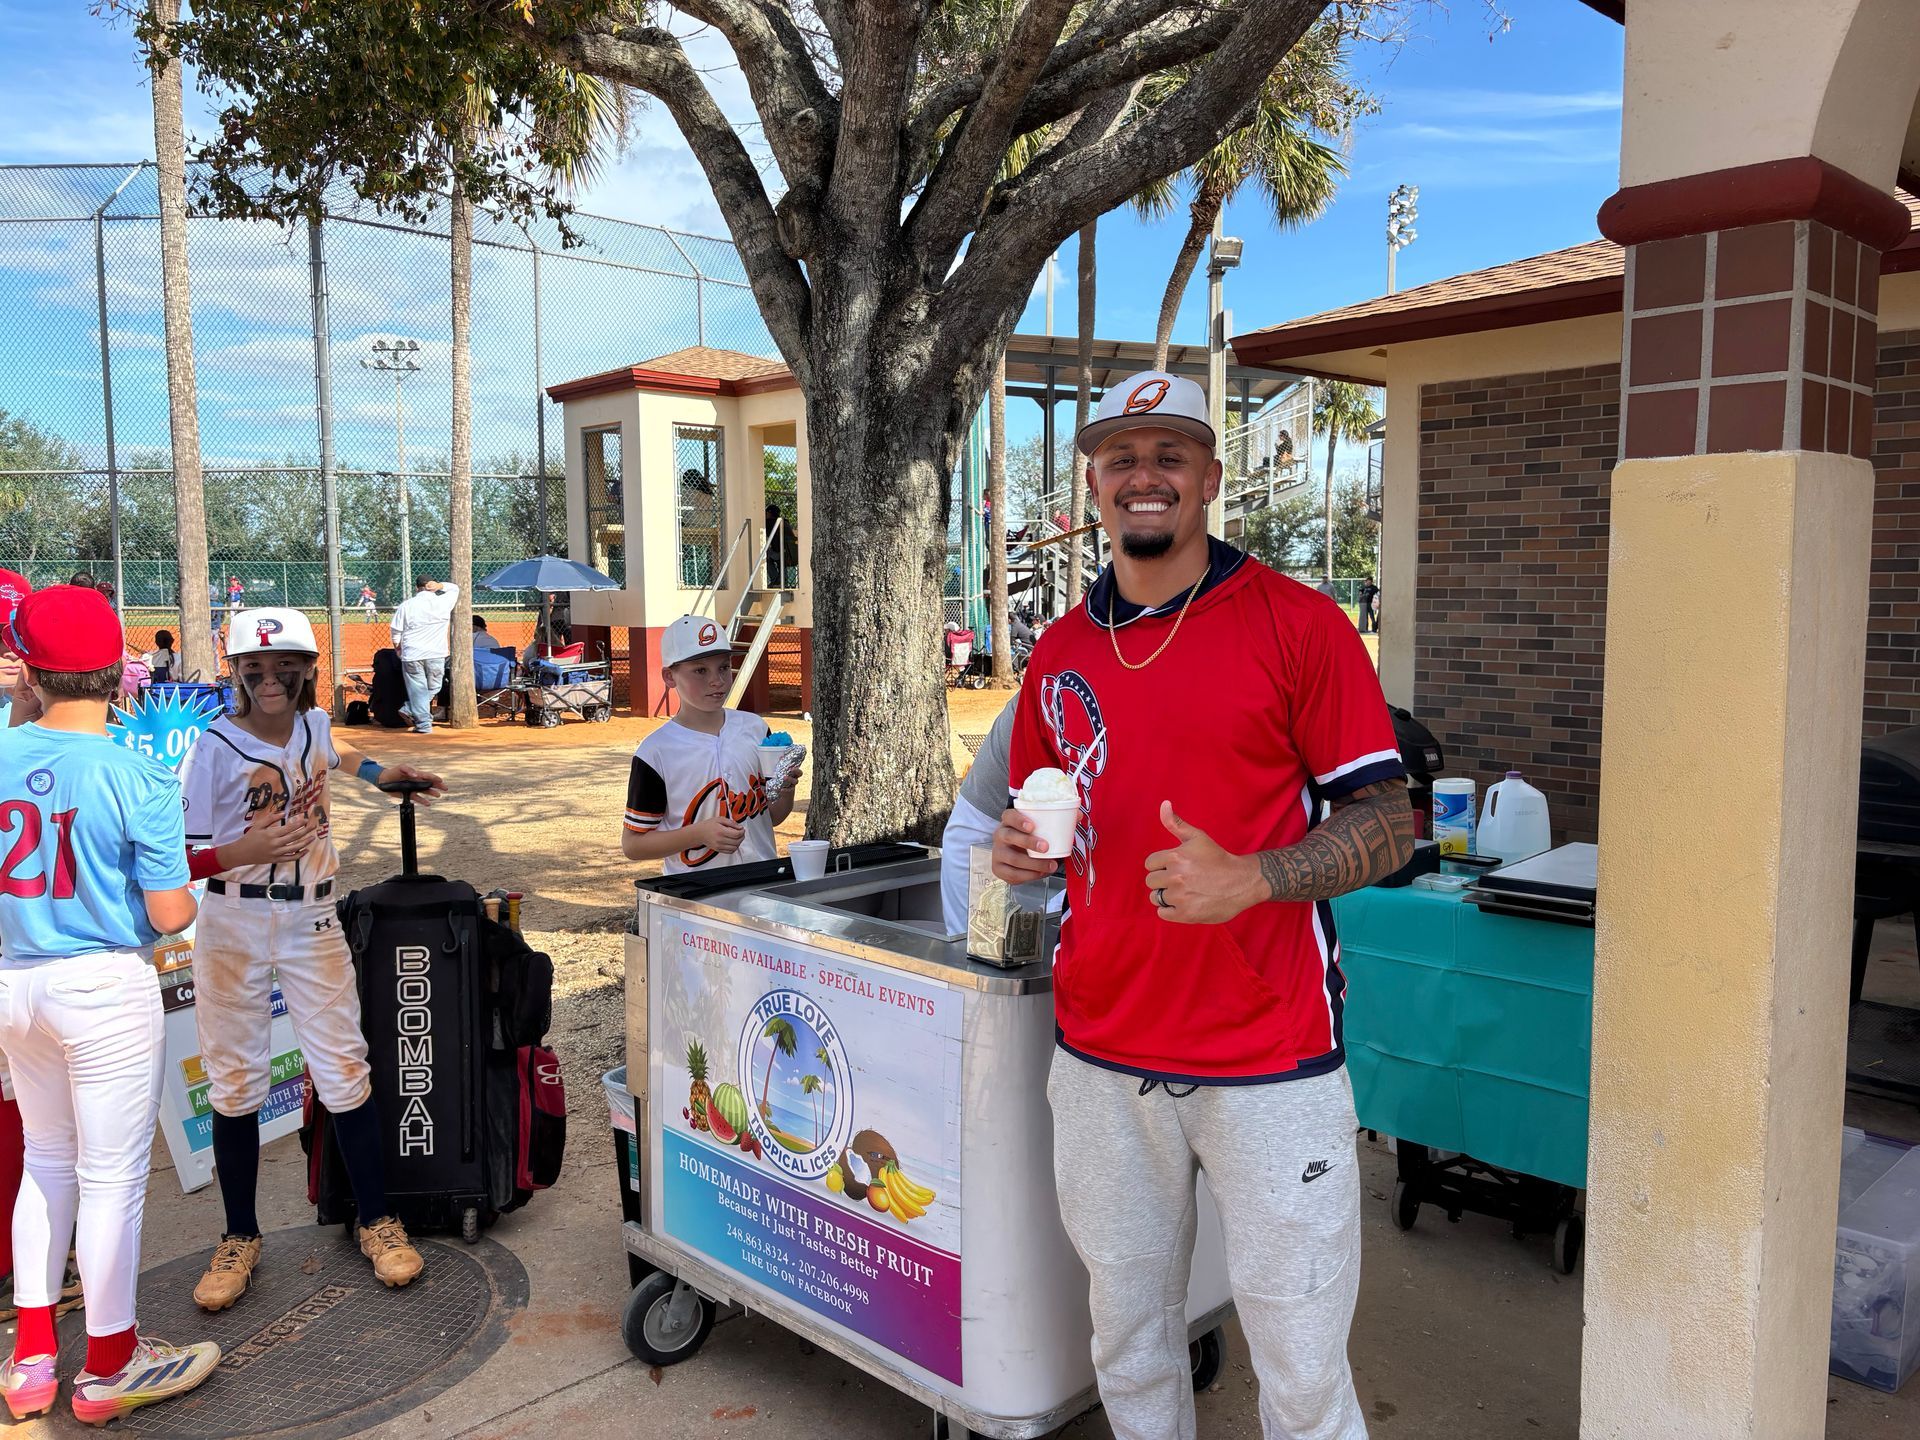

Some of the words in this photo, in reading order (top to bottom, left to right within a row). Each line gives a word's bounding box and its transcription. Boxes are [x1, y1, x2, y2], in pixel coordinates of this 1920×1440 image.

[0, 799, 79, 900] 21
[163, 950, 193, 967] Man
[682, 932, 739, 960] CATERING
[741, 948, 807, 979] AVAILABLE
[818, 970, 875, 999] SPECIAL
[878, 985, 935, 1017] EVENTS
[395, 945, 434, 1157] BOOMBAH
[754, 994, 792, 1023] TRUE
[794, 997, 835, 1047] LOVE
[263, 1088, 292, 1109] WITH
[751, 1112, 808, 1173] TROPICAL
[809, 1144, 837, 1173] ICES
[1306, 1159, 1329, 1174] NIKE
[679, 1151, 761, 1207] HOMEMADE
[765, 1193, 809, 1230] WITH
[813, 1215, 870, 1259] FRESH
[876, 1244, 934, 1287] FRUIT
[718, 1191, 758, 1222] Because
[761, 1212, 771, 1229] It
[772, 1218, 796, 1241] Just
[798, 1230, 837, 1260] Tastes
[840, 1250, 879, 1280] Better
[726, 1223, 789, 1266] 248.863.8324
[798, 1259, 870, 1305] 207.206.4998
[741, 1248, 764, 1270] LIKE
[765, 1261, 779, 1278] US
[781, 1269, 796, 1287] ON
[797, 1277, 854, 1315] FACEBOOK
[218, 1288, 347, 1370] ELECTRIC
